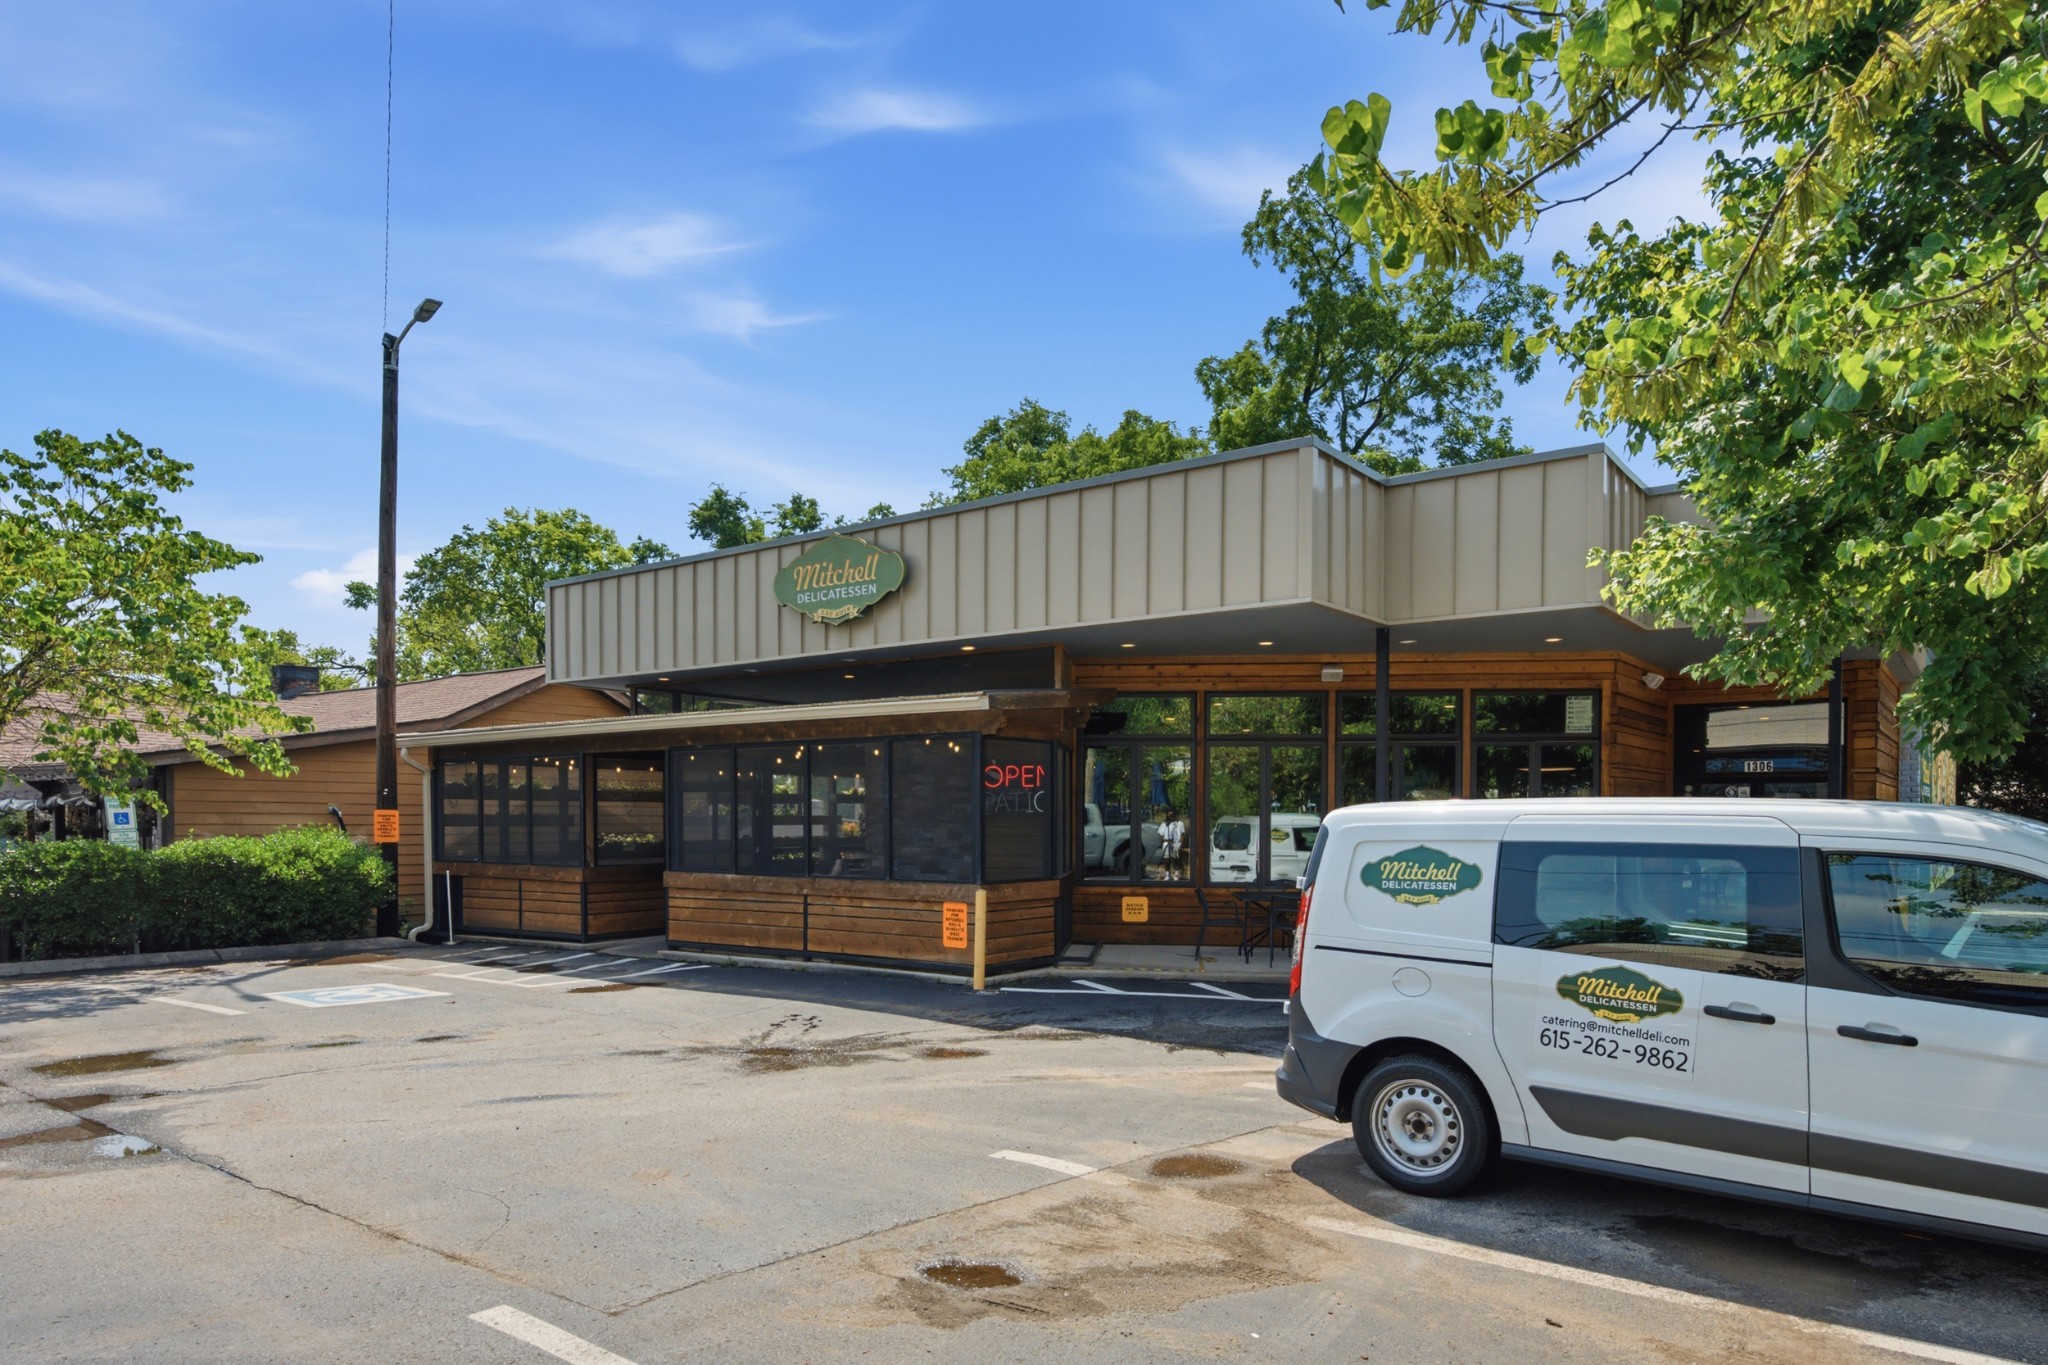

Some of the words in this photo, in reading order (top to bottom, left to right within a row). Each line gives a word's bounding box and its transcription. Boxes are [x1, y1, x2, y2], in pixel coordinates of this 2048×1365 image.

[793, 553, 879, 591] Mitchell
[797, 583, 877, 604] DELICATESSEN
[1746, 761, 1773, 772] 1306
[1380, 861, 1462, 881] Mitchell
[1382, 880, 1457, 891] DELICATESSEN
[1577, 976, 1662, 1004] Mitchell
[1579, 994, 1657, 1013] DELICATESSEN
[1541, 1015, 1690, 1047] catering@mitchelldeli.com
[1540, 1028, 1688, 1072] 615-262-9862
